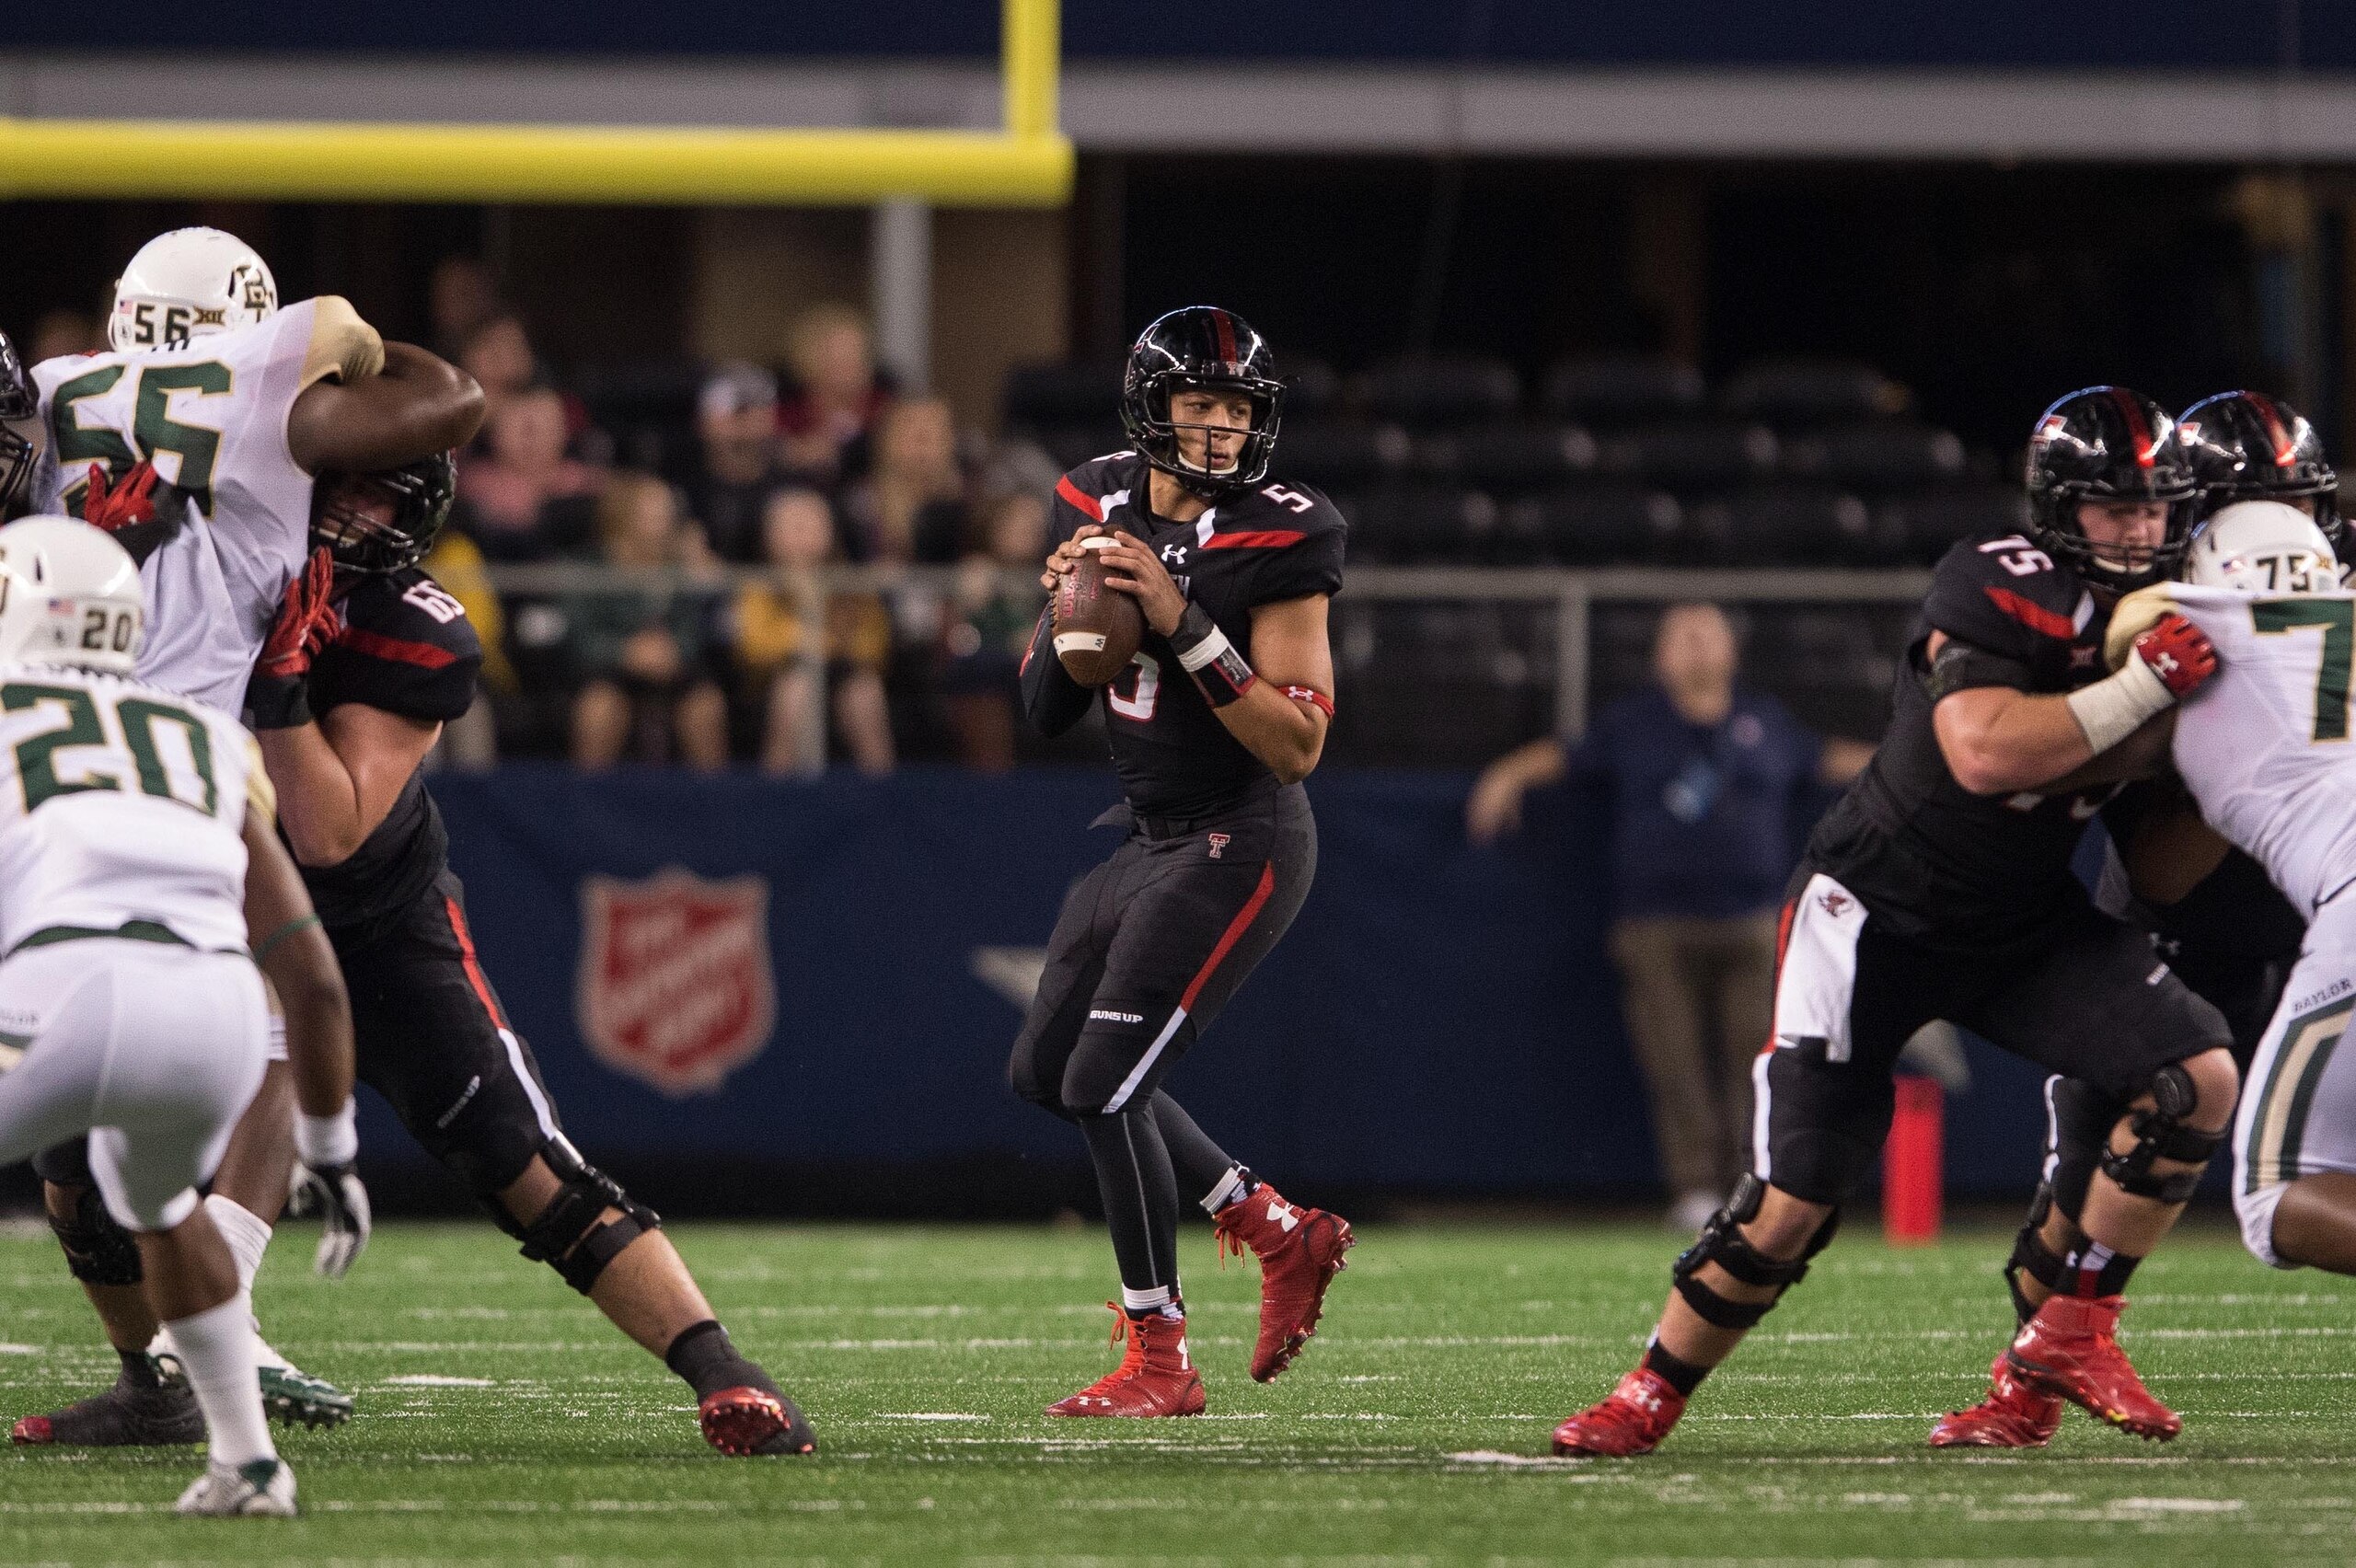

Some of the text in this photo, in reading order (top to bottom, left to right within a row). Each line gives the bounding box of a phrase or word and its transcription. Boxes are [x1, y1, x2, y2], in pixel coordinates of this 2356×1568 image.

[134, 303, 191, 346] 56
[1260, 484, 1314, 513] 5
[1977, 534, 2055, 577] 75
[2256, 555, 2311, 592] 75
[81, 609, 133, 651] 20
[0, 683, 219, 819] 20
[1090, 1009, 1144, 1023] GUNS UP
